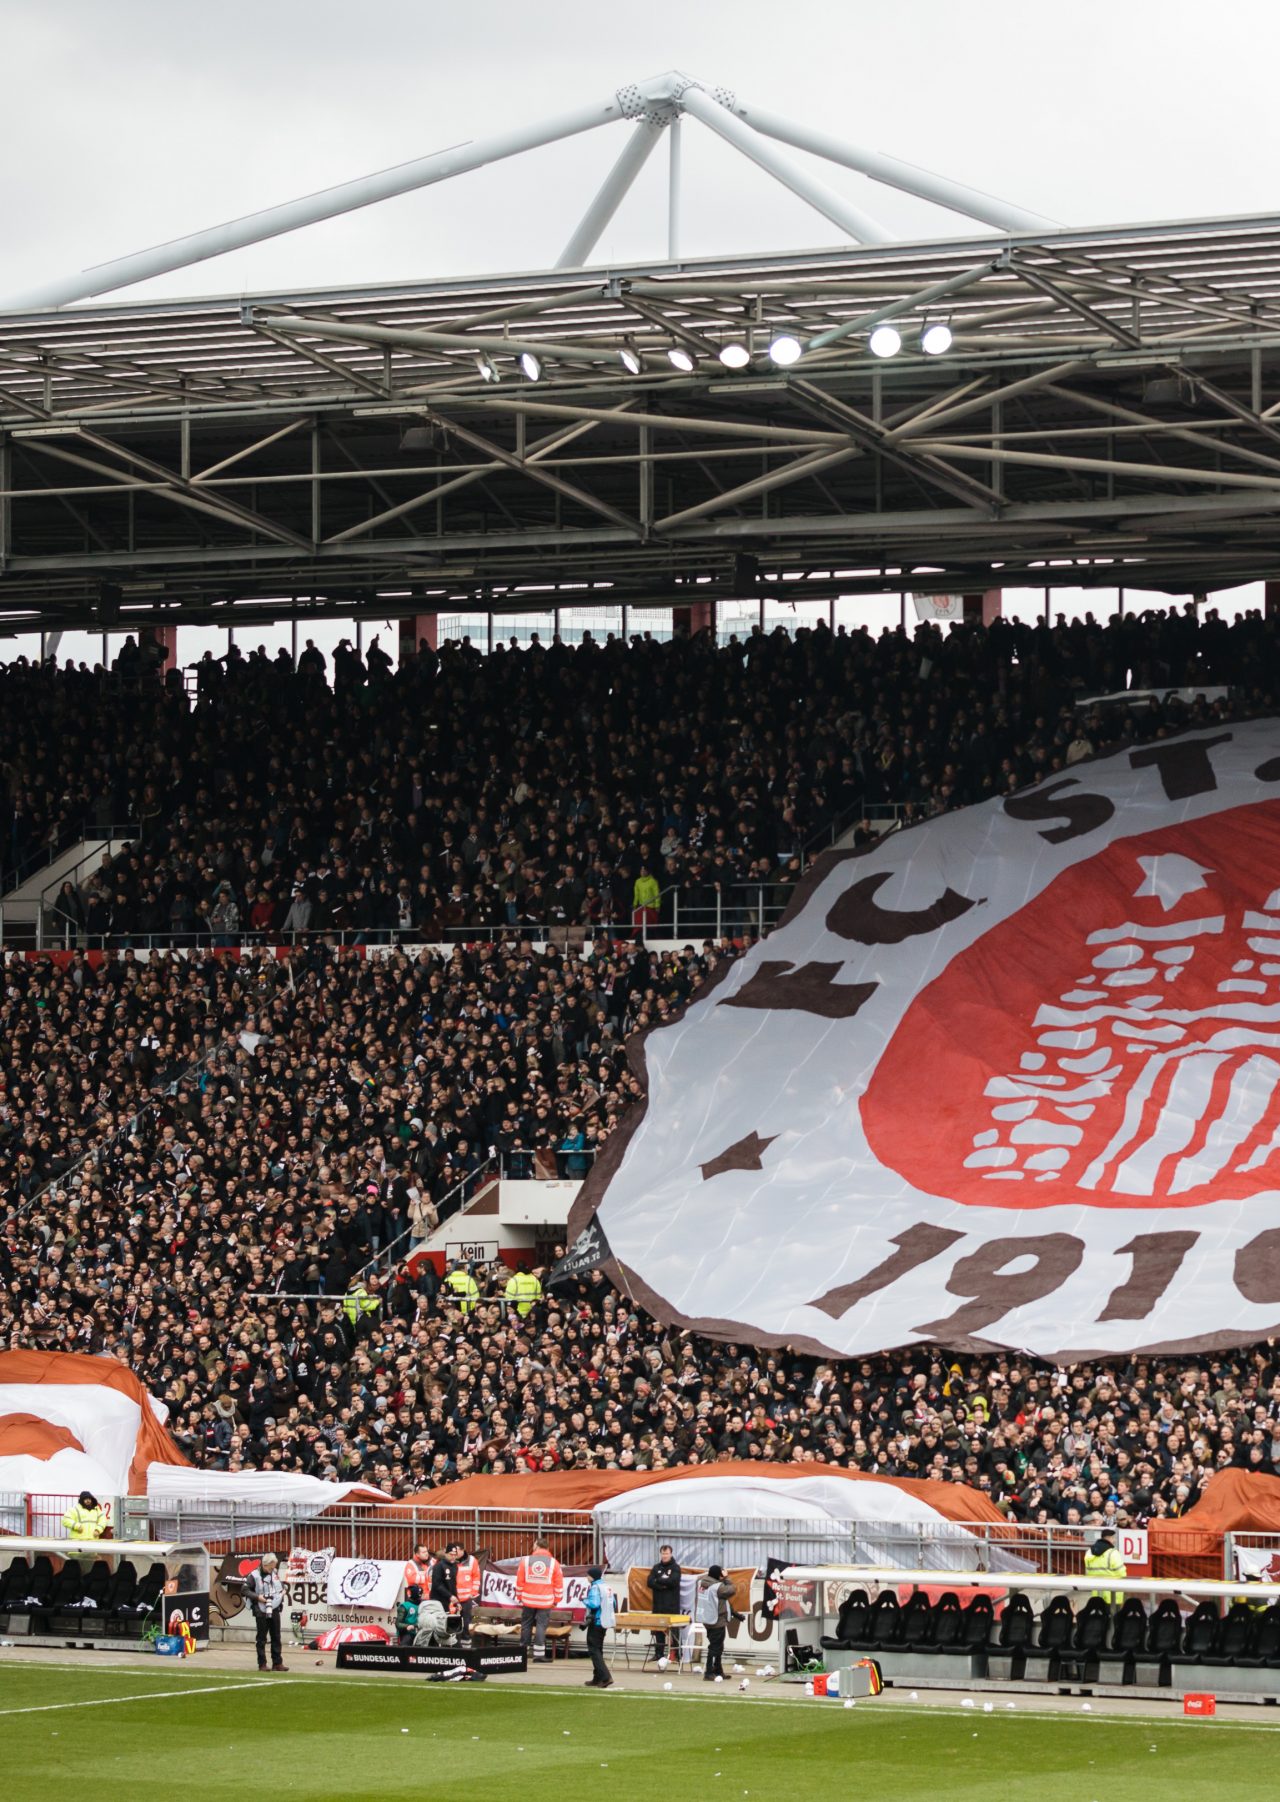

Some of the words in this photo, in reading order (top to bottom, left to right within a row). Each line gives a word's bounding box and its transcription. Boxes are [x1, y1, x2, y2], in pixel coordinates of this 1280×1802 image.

[716, 871, 987, 1018] FC
[461, 1243, 485, 1260] kein
[1123, 1537, 1142, 1556] D1
[353, 1654, 400, 1664] BUNDESLIGA
[417, 1656, 466, 1667] BUNDESLIGA
[480, 1655, 522, 1666] BUNDESLIGA.DE
